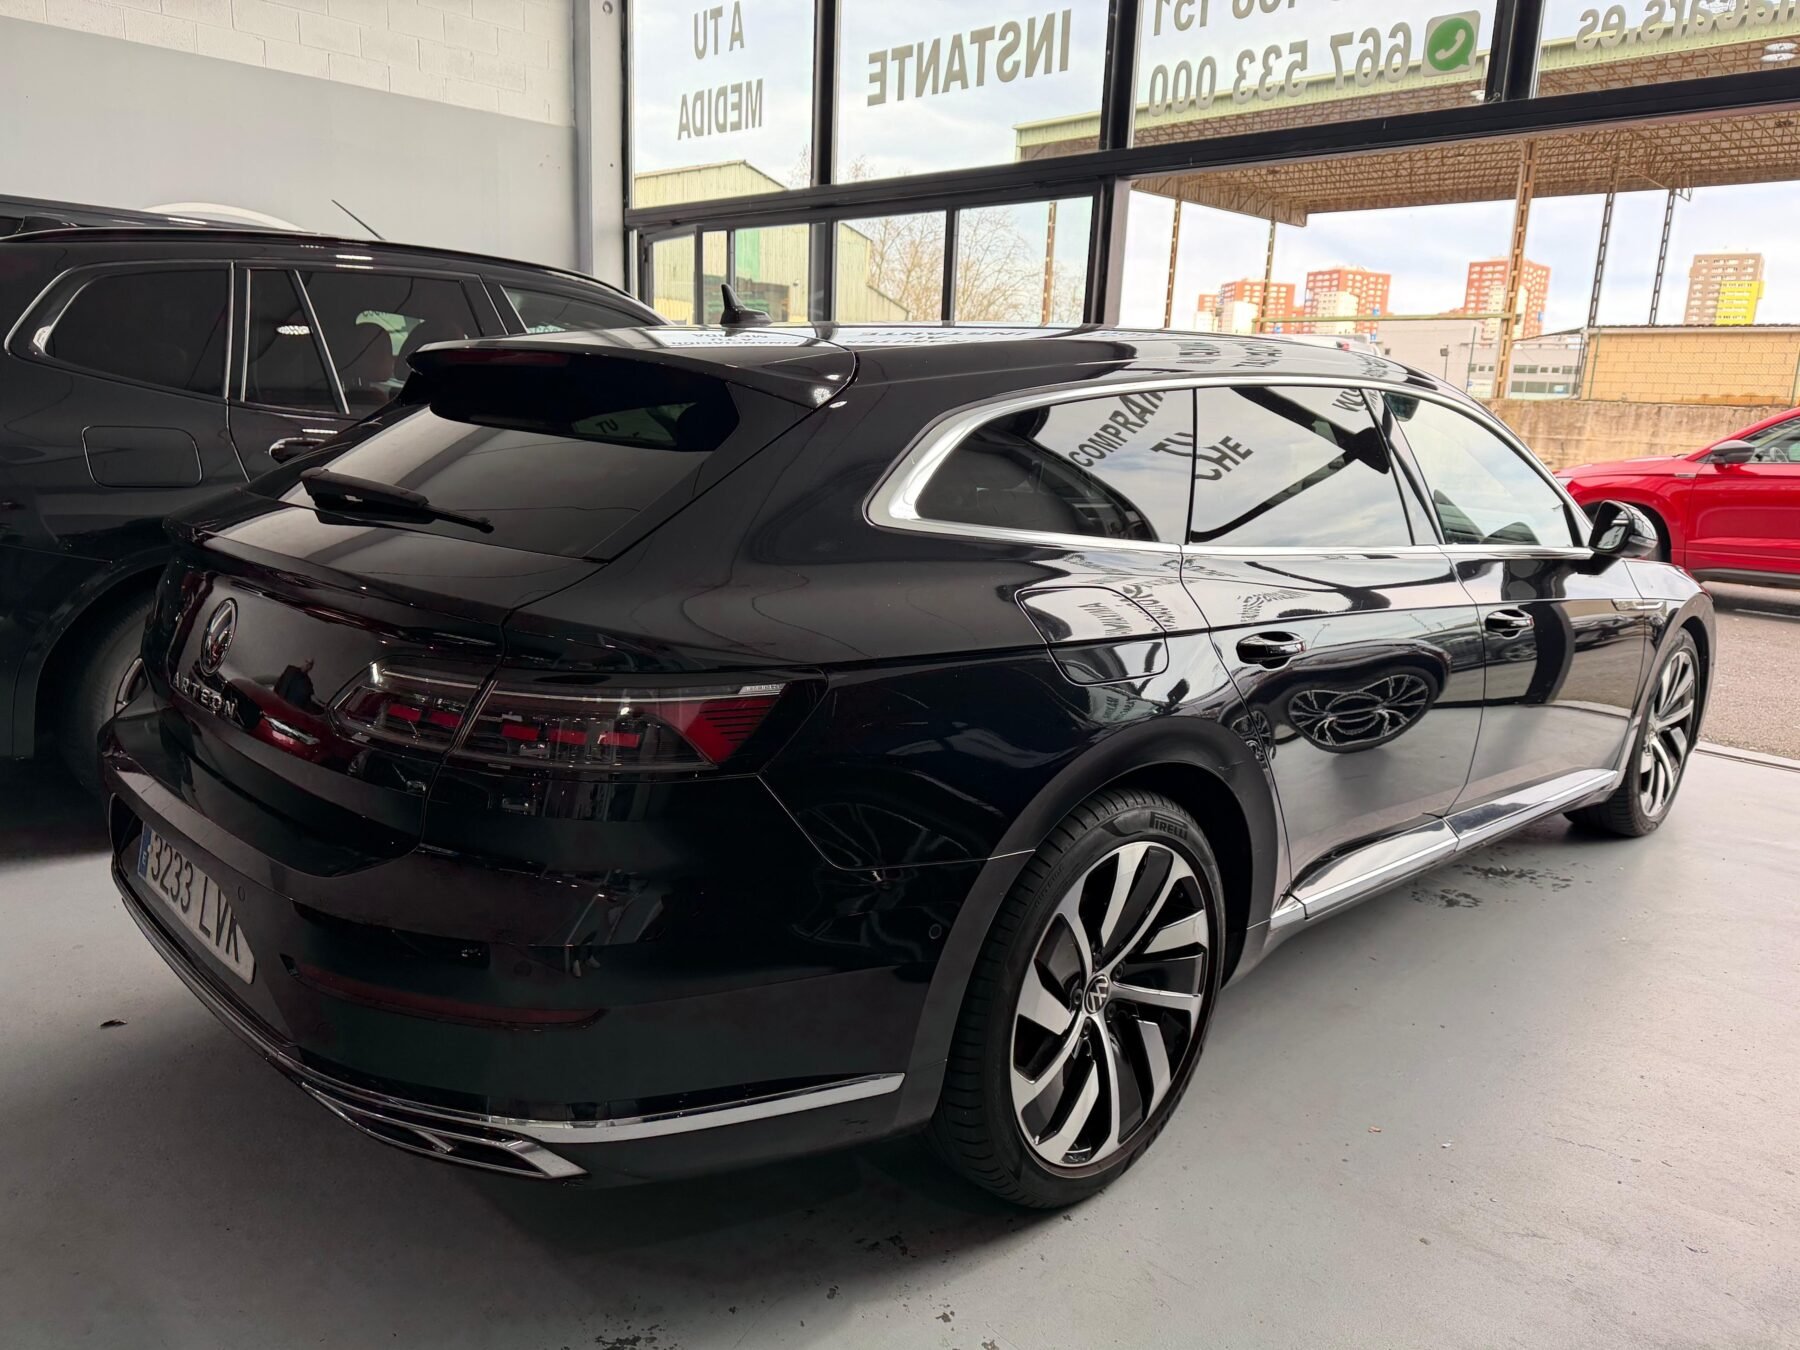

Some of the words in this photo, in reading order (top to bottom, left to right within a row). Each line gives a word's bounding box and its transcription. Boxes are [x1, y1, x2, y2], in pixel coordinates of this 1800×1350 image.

[1150, 811, 1188, 841] PIRELLI
[151, 834, 194, 914] 3233
[199, 876, 241, 963] LVK
